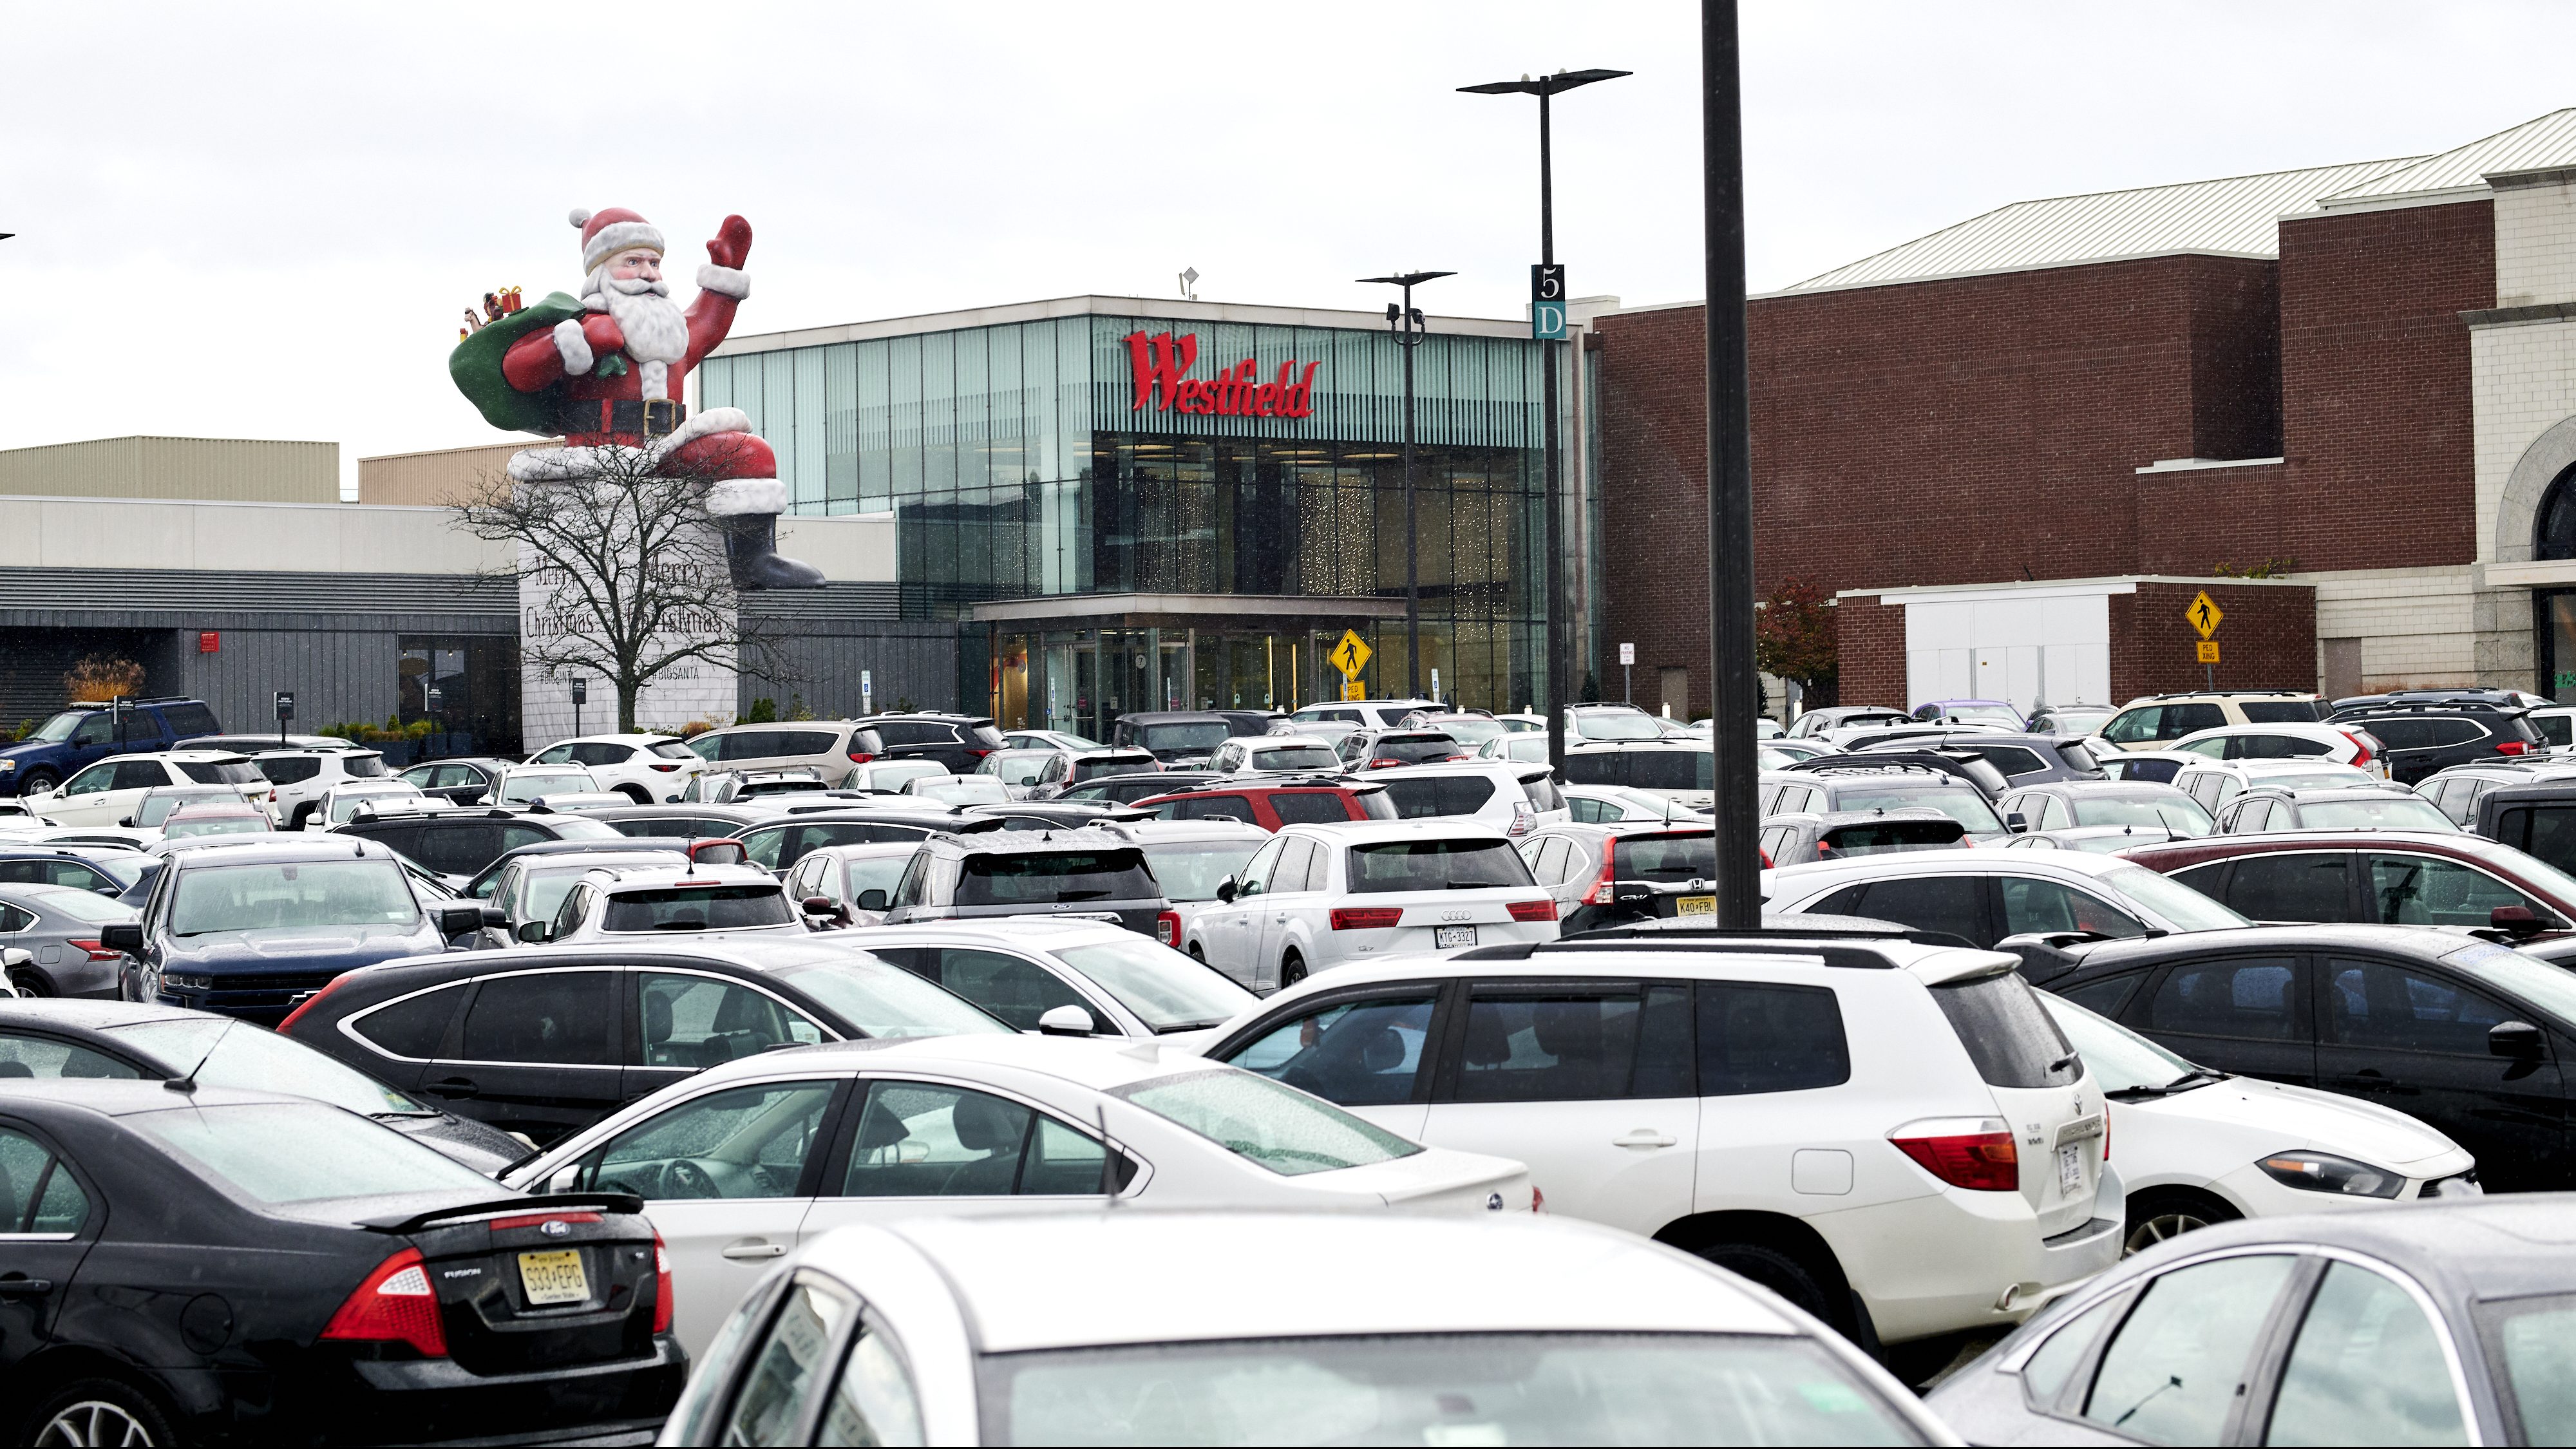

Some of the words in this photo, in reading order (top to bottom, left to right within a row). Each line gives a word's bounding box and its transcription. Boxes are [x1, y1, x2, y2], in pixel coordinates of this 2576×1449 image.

[1540, 267, 1560, 298] 5
[1539, 307, 1564, 334] D
[1121, 330, 1322, 419] Westfield
[627, 604, 723, 633] Chistmas
[1139, 658, 1143, 666] 7
[652, 667, 699, 680] #BIGSANTA
[1680, 903, 1695, 914] K40
[1699, 901, 1714, 912] FBL
[1439, 932, 1452, 943] KTG
[1456, 931, 1473, 942] 3327
[444, 1268, 482, 1278] FUSION
[526, 1267, 552, 1291] S33
[556, 1264, 583, 1289] EPG
